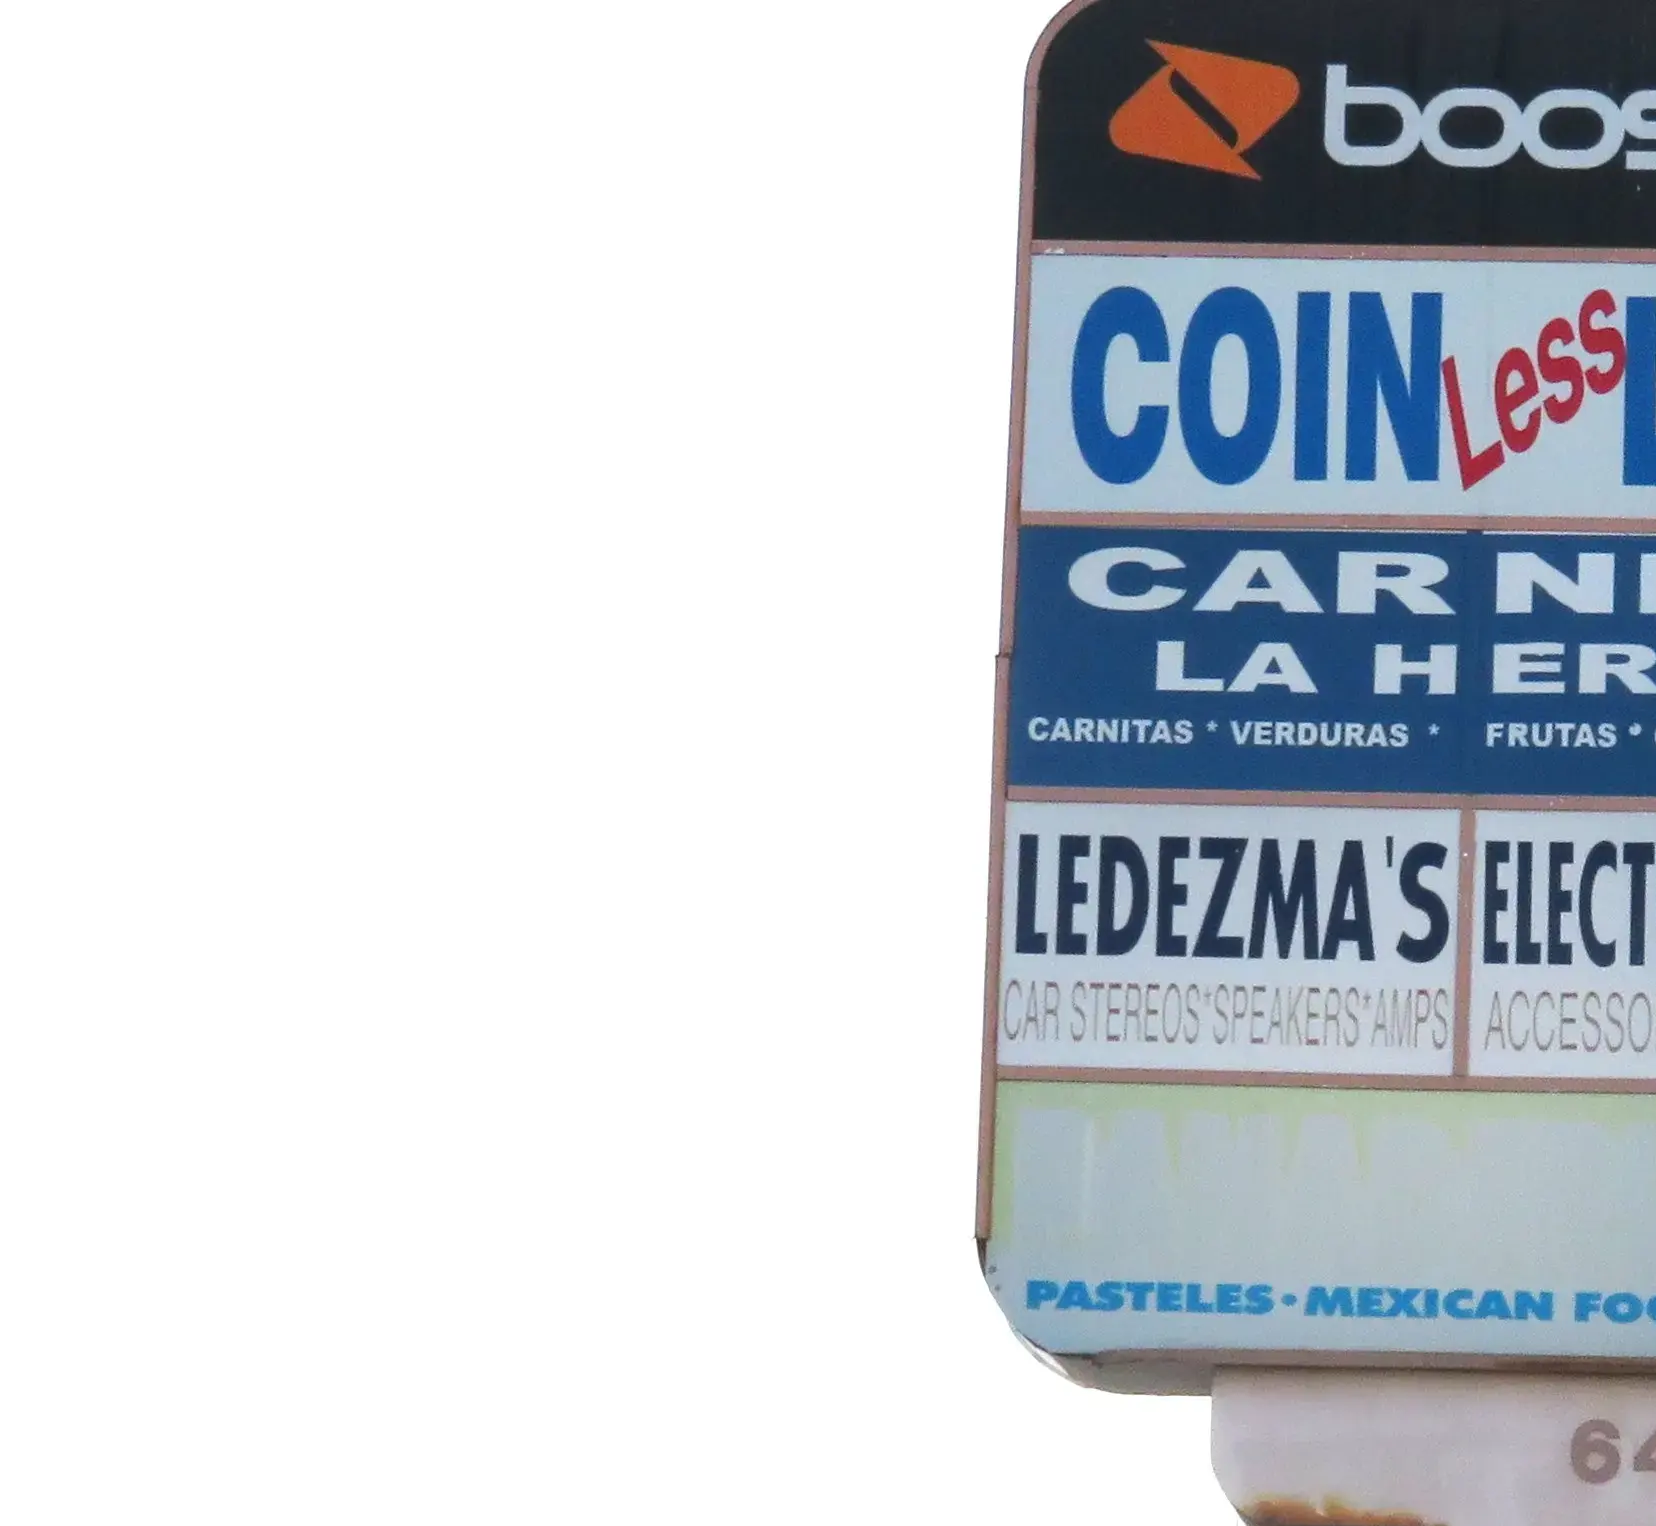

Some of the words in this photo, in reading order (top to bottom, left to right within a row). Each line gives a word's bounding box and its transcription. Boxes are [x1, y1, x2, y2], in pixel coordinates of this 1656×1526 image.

[1071, 286, 1443, 486] COIN
[1441, 288, 1626, 491] Less
[1155, 641, 1318, 693] LA
[1028, 716, 1193, 744] CARNITAS
[1231, 719, 1409, 748] VERDURAS
[1485, 722, 1617, 749] FRUTAS
[1015, 833, 1449, 963] LEDEZMA'S
[1003, 979, 1061, 1041] CAR
